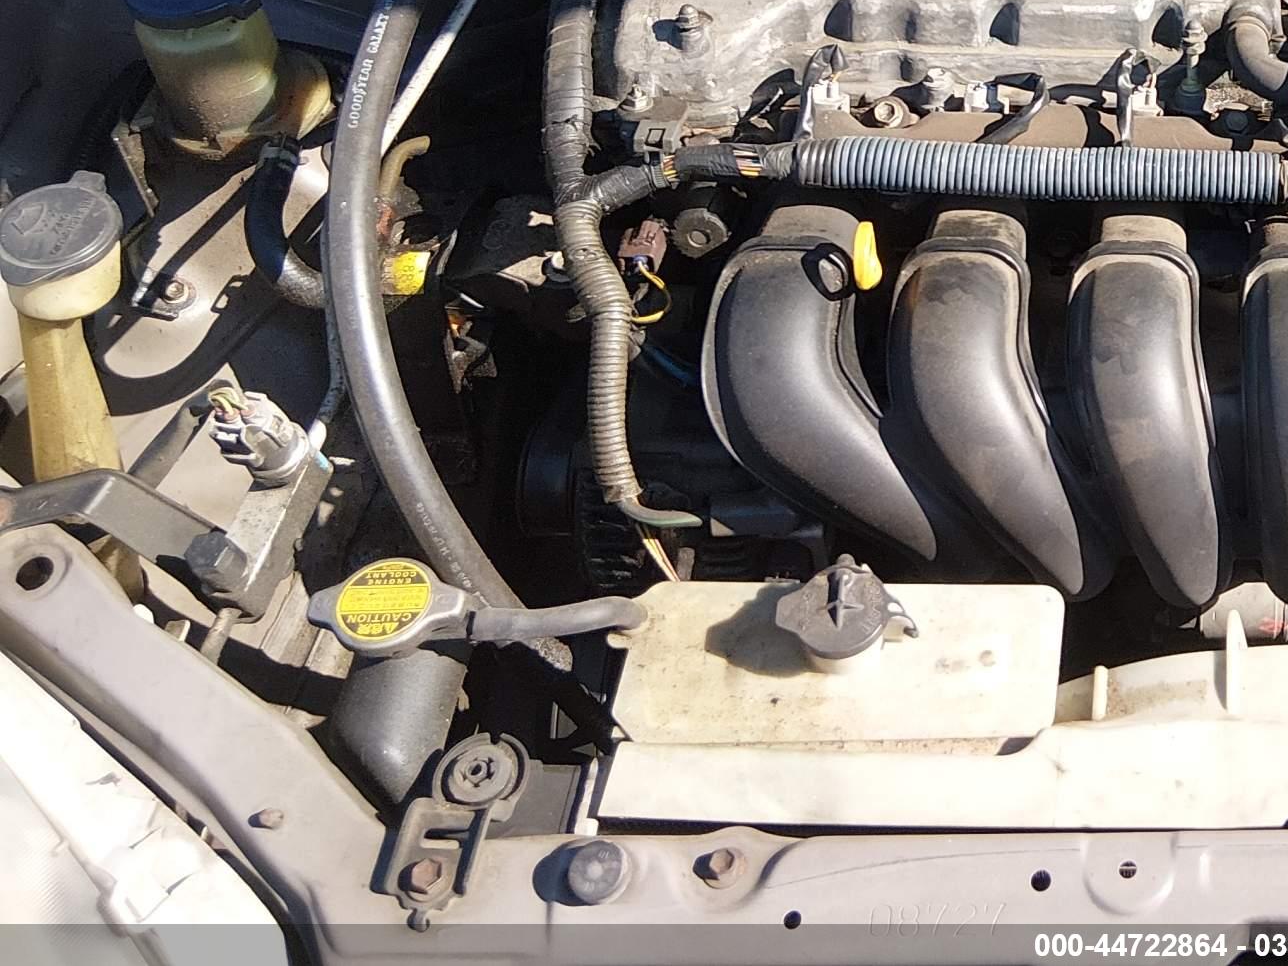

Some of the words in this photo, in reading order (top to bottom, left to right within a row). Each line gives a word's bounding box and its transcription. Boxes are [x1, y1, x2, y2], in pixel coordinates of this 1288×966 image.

[347, 58, 374, 129] GOODYEAR
[366, 11, 390, 54] GALAXY
[365, 571, 417, 579] COOLANT
[366, 578, 412, 586] ENGINE
[346, 612, 412, 624] CAUTION
[869, 903, 1006, 937] 08727
